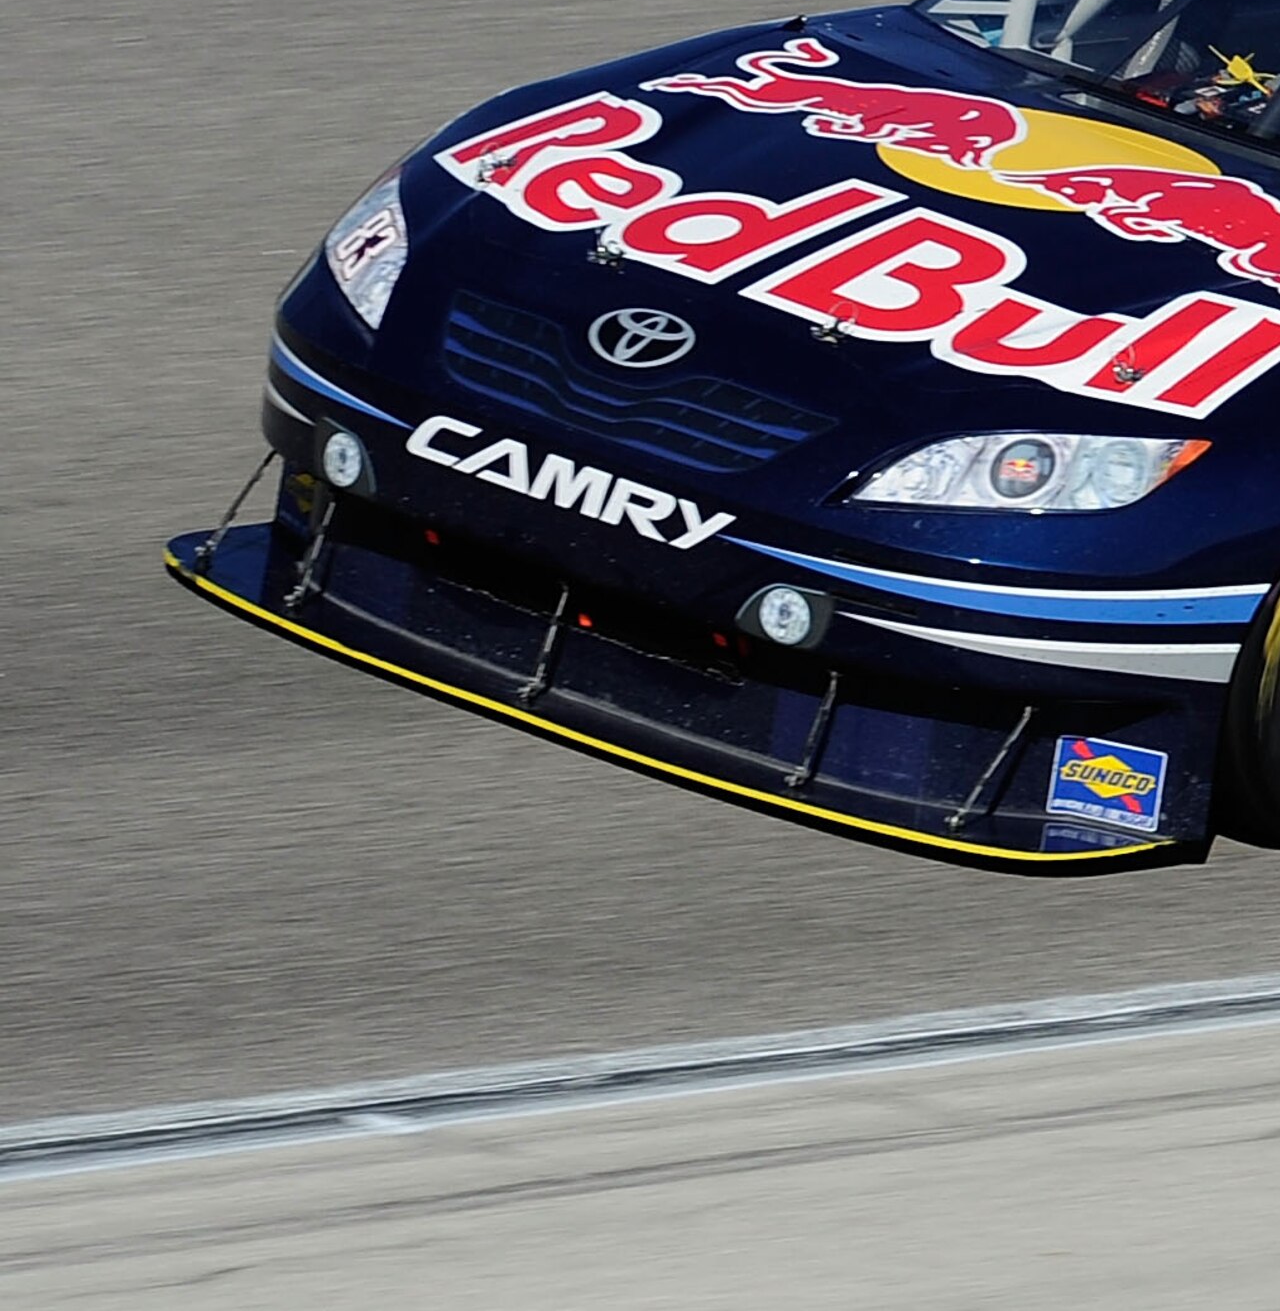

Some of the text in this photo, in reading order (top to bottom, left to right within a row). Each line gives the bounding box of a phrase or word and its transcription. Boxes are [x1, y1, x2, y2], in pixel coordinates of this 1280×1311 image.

[433, 91, 908, 285] Red
[334, 208, 401, 282] 83
[406, 415, 737, 550] CAMRY
[1064, 762, 1151, 791] SUNOCO
